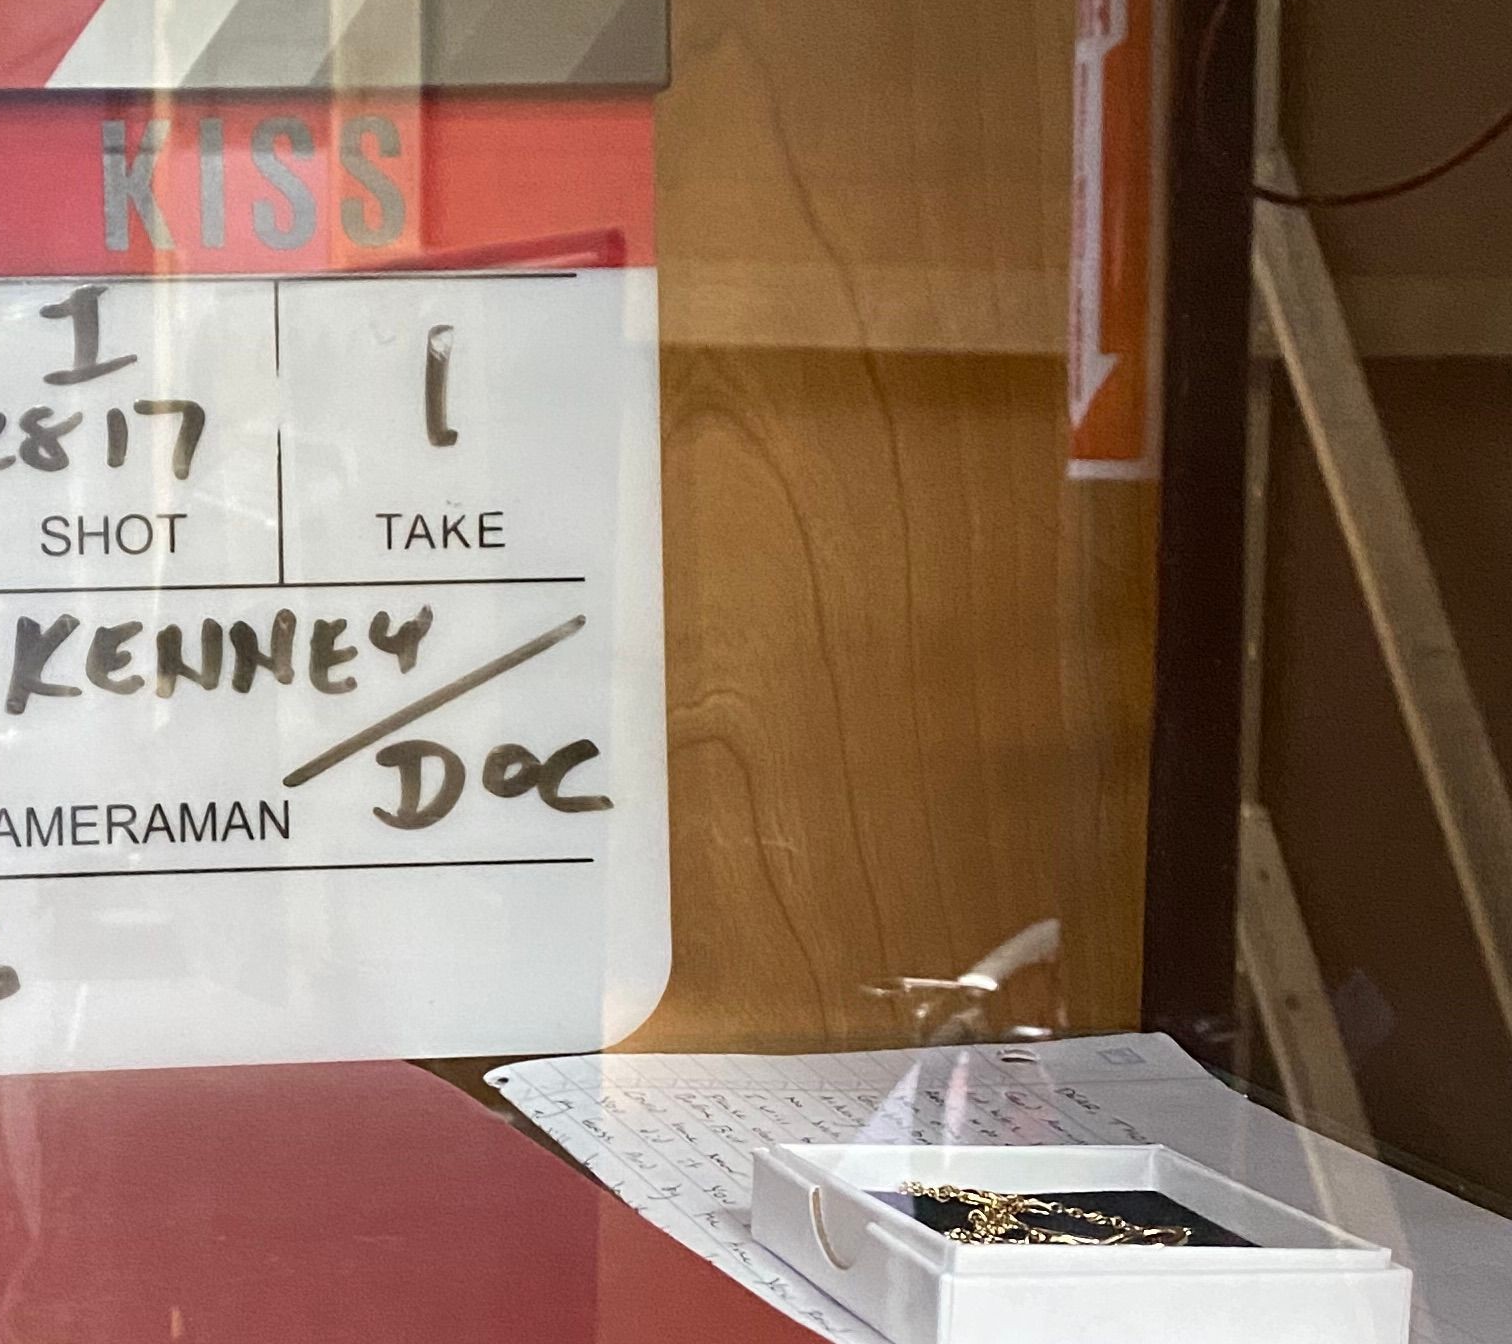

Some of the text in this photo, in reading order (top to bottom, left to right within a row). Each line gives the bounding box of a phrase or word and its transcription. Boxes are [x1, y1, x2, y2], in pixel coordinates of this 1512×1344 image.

[101, 116, 407, 253] KISS
[39, 513, 188, 557] SHOT
[375, 511, 506, 553] TAKE
